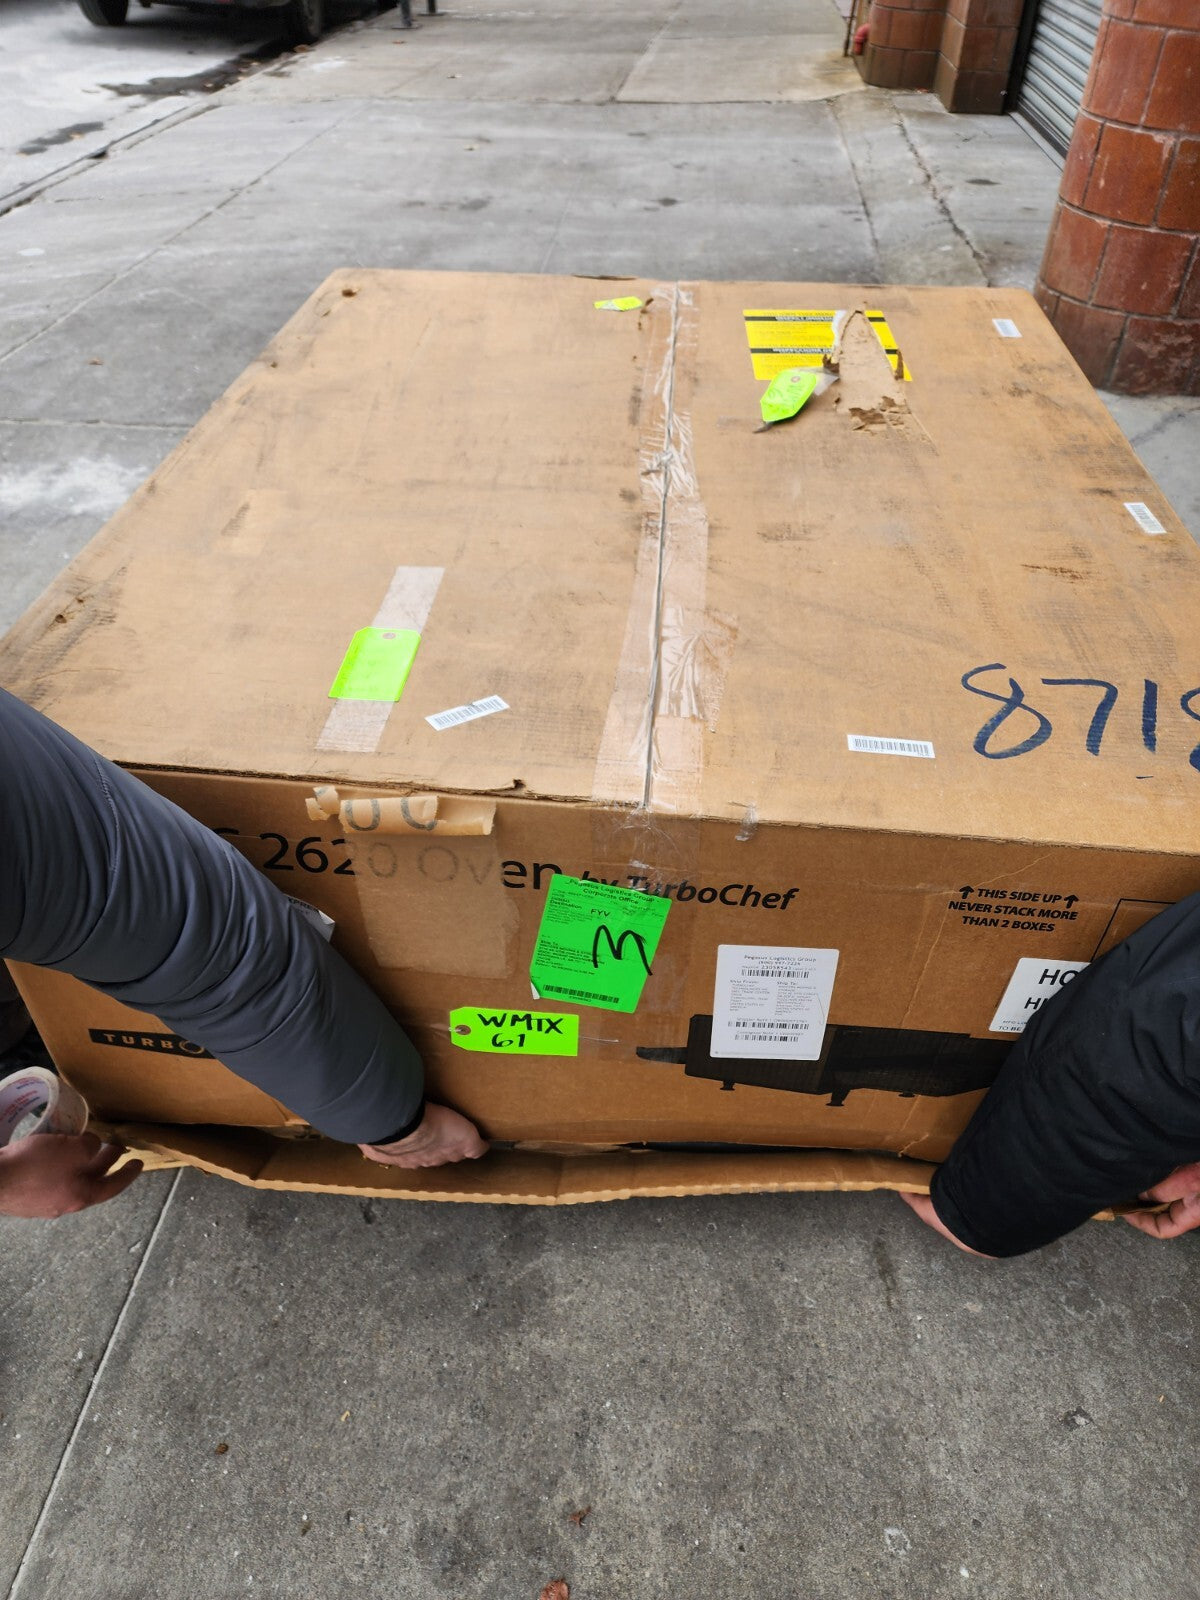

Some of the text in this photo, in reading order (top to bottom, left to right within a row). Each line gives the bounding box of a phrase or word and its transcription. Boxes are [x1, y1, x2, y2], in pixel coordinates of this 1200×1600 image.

[961, 663, 1200, 773] 871
[259, 832, 398, 878] 2620
[417, 845, 564, 891] Oven
[627, 875, 800, 910] TurboChef
[582, 888, 617, 900] Corporate
[618, 896, 639, 905] Office
[600, 883, 632, 896] Logistics
[977, 888, 1063, 904] THIS SIDE UP
[590, 908, 611, 917] FYV
[948, 900, 1079, 921] NEVER STACK MORE
[962, 915, 1056, 932] THAN 2 BOXES
[491, 1032, 526, 1048] 61
